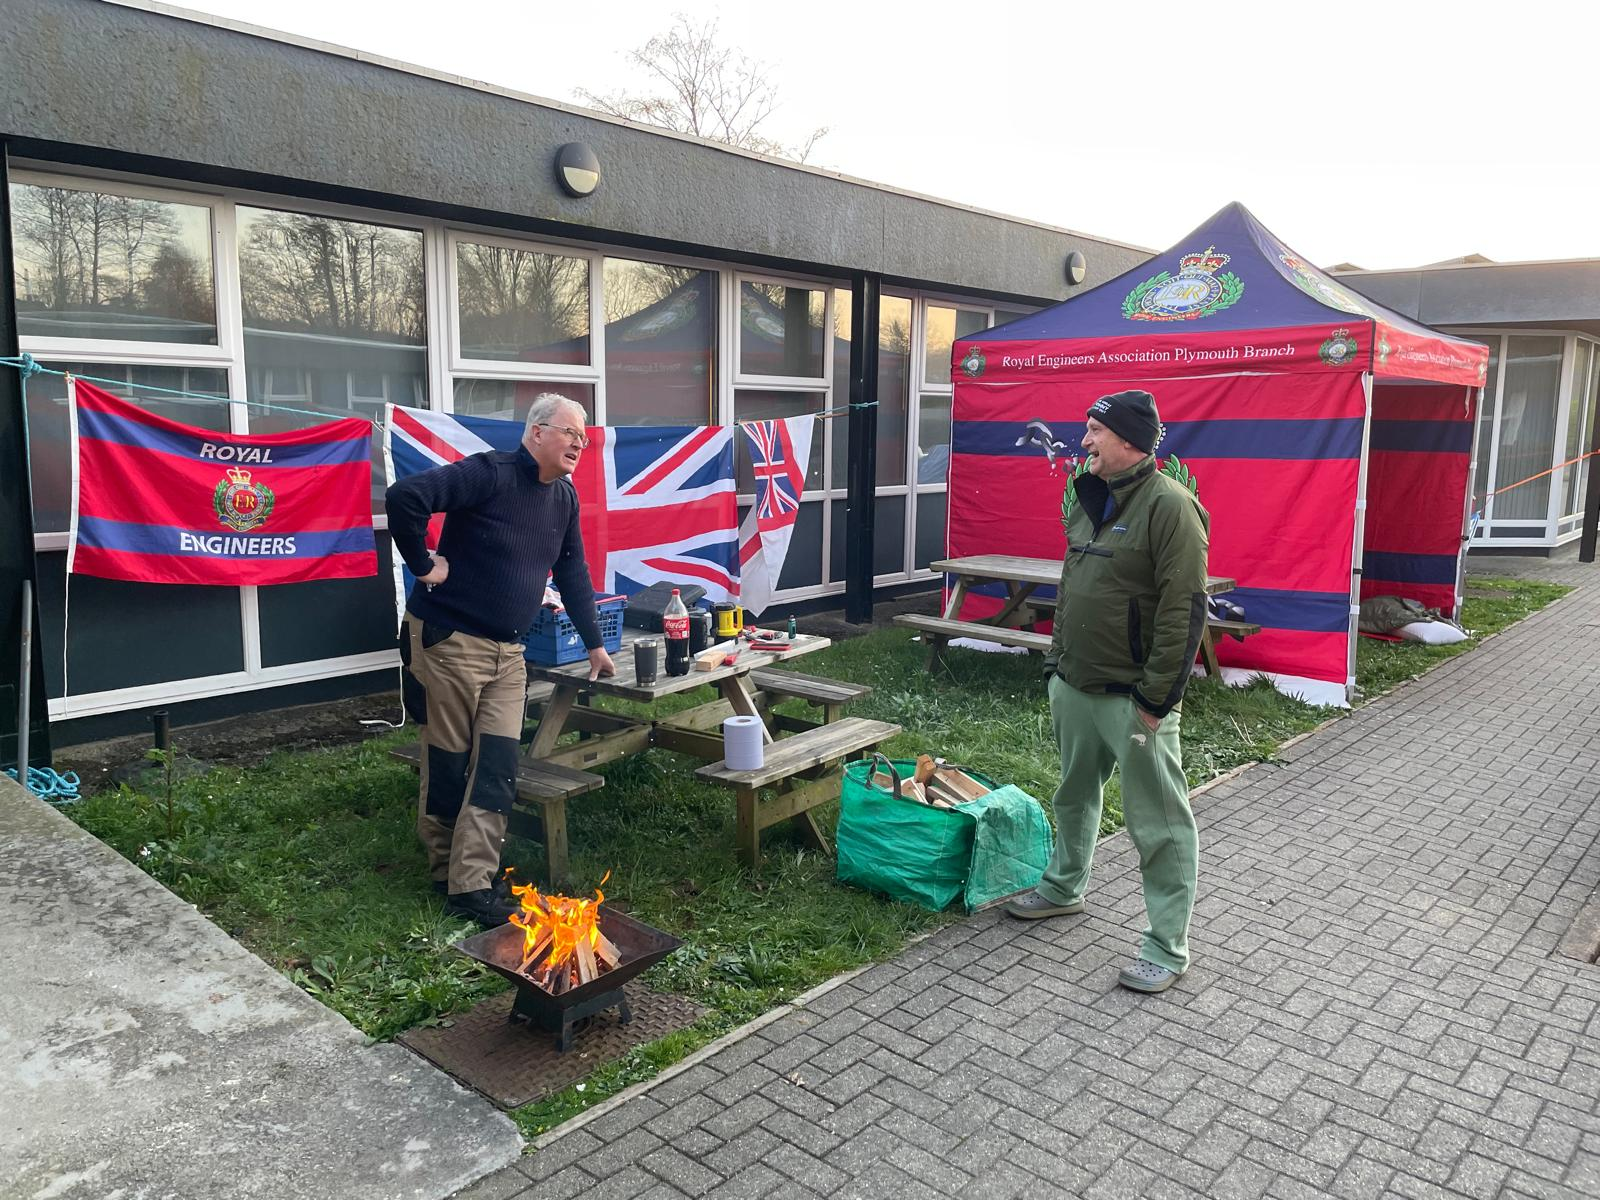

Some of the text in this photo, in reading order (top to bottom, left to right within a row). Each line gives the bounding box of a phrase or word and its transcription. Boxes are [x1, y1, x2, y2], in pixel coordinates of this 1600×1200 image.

[1002, 344, 1295, 369] Royal Engineers Association Plymouth Branch
[199, 442, 273, 463] ROYAL
[180, 532, 297, 555] ENGINEERS
